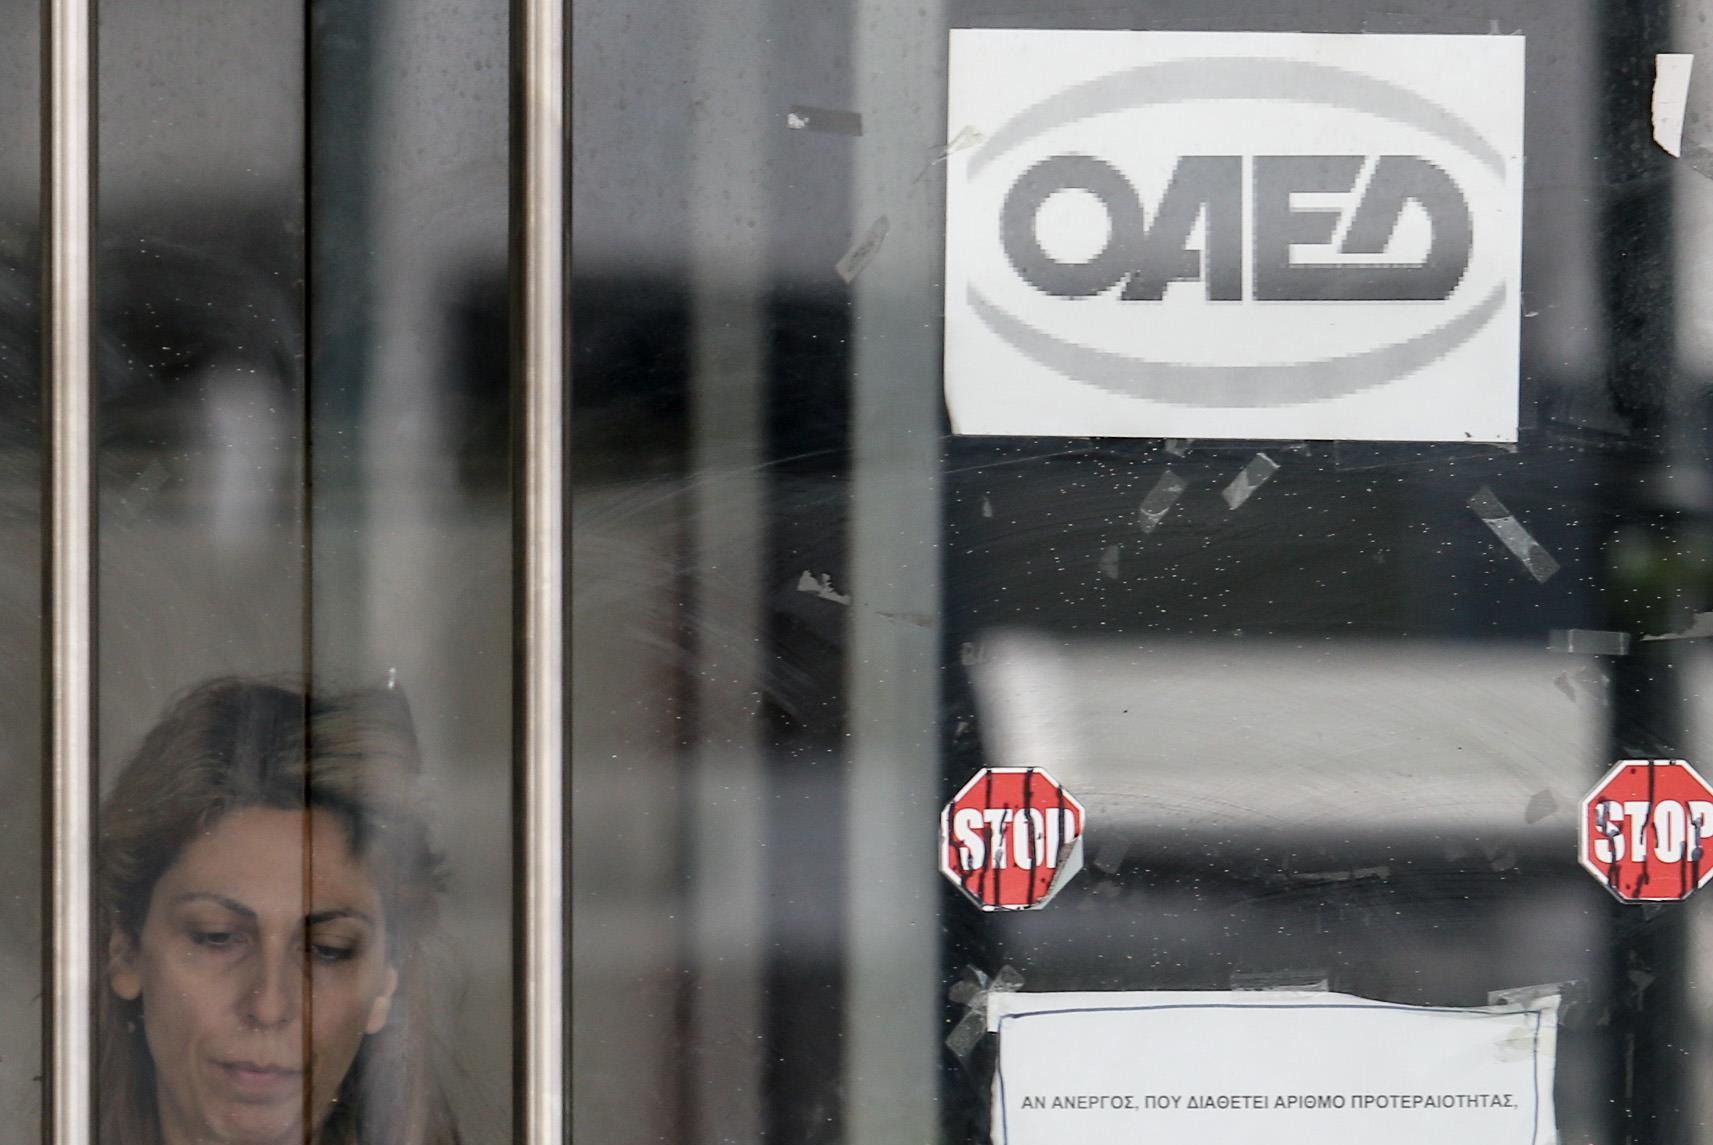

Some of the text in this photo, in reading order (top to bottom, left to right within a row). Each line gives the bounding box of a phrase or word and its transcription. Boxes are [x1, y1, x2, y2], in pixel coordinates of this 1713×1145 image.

[953, 808, 1076, 870] STOP
[1594, 800, 1713, 864] STOP
[1022, 1094, 1517, 1111] ΑΝ ΑΝΕΡΓΟΣ, ΠΟΥ ΔΙΑΘΕΤΕΙ ΑΡΙΘΜΟ ΠΡΟΤΕΡΑΙΟΤΗΤΑΣ,
